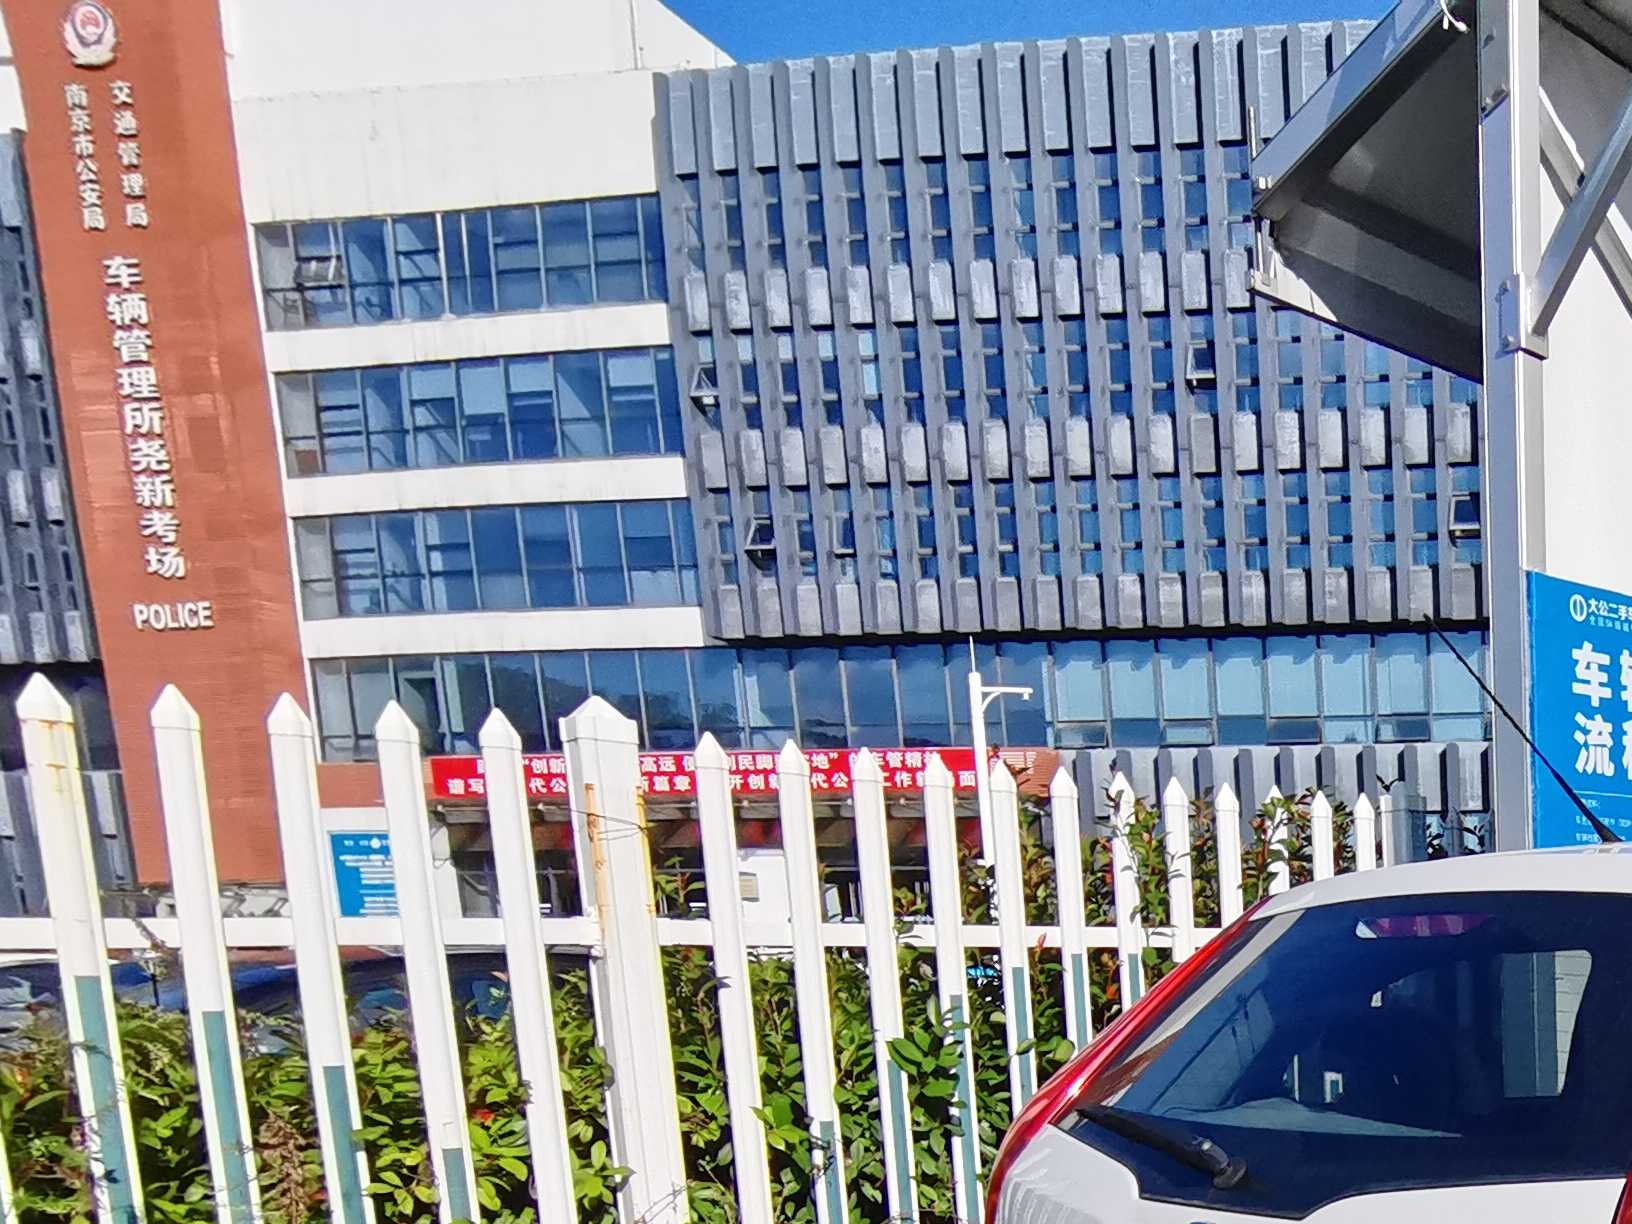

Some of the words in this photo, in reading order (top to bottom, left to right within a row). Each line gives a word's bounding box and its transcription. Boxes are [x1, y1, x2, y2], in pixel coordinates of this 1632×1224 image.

[64, 83, 105, 230] 南京市公安局
[109, 80, 149, 229] 交通管理局
[103, 256, 186, 579] 车辆管理所尧新考场
[132, 601, 215, 630] POLICE
